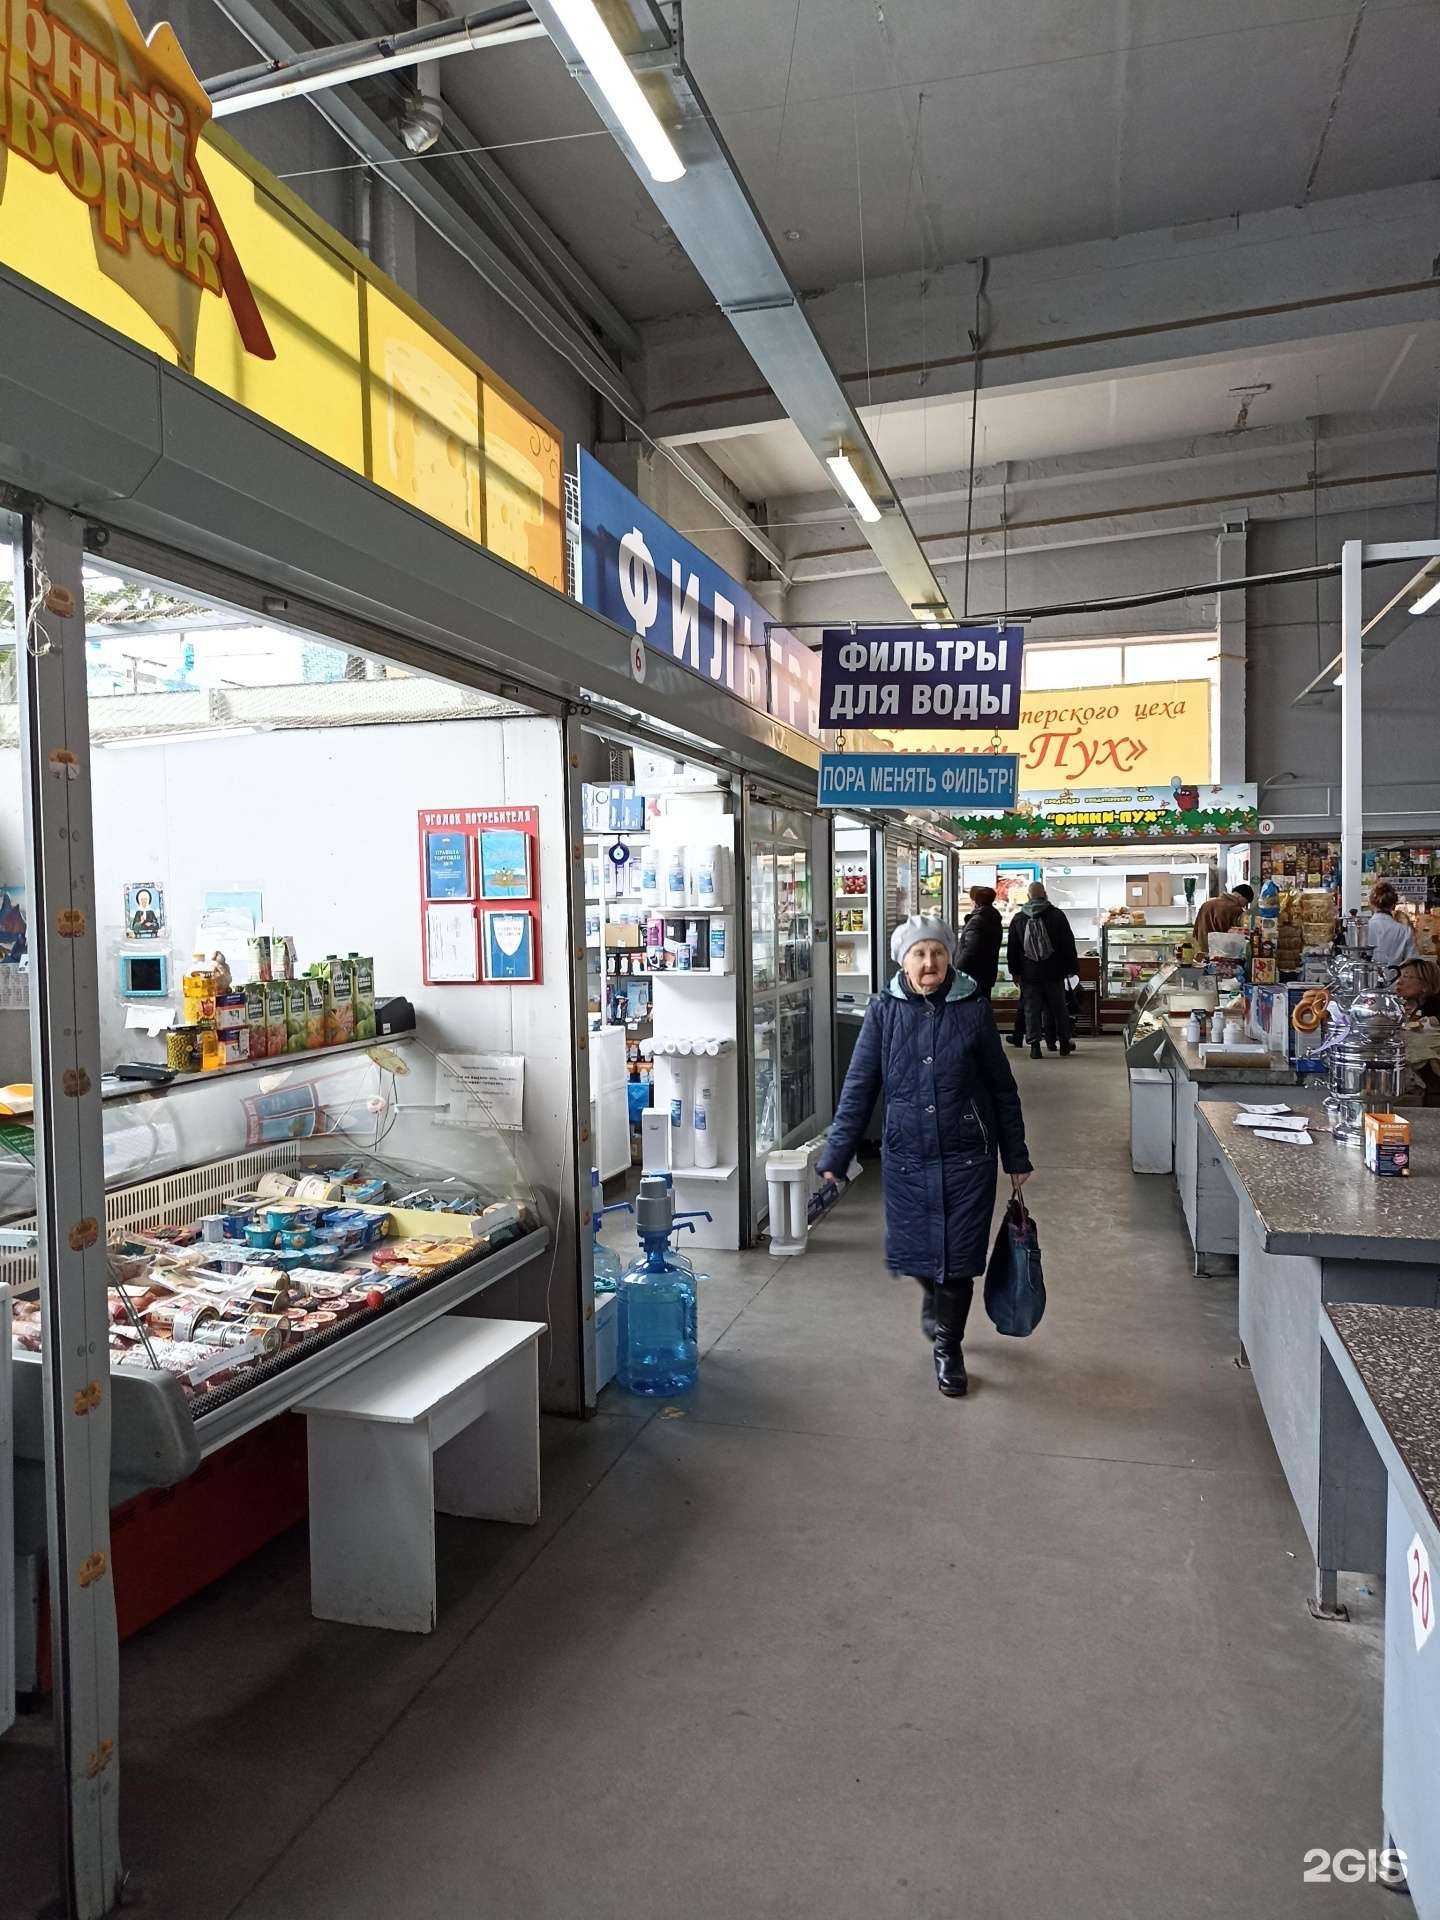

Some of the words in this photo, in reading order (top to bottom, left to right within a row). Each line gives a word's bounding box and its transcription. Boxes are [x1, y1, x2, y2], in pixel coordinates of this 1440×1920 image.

[0, 76, 222, 291] ворик
[635, 648, 641, 673] 6
[838, 640, 1008, 672] ФИЛЬТРЫ
[830, 684, 899, 719] ДЛЯ
[911, 684, 1011, 720] ВОДЫ
[1134, 700, 1186, 721] цеха
[823, 766, 865, 791] ПОРА
[870, 767, 936, 793] МЕНЯТЬ
[941, 768, 1013, 793] ФИЛЬТР!
[425, 812, 461, 826] УГОЛОК
[465, 810, 531, 825] ПОТРЕБИТЕЛЯ
[1411, 1548, 1431, 1631] 20
